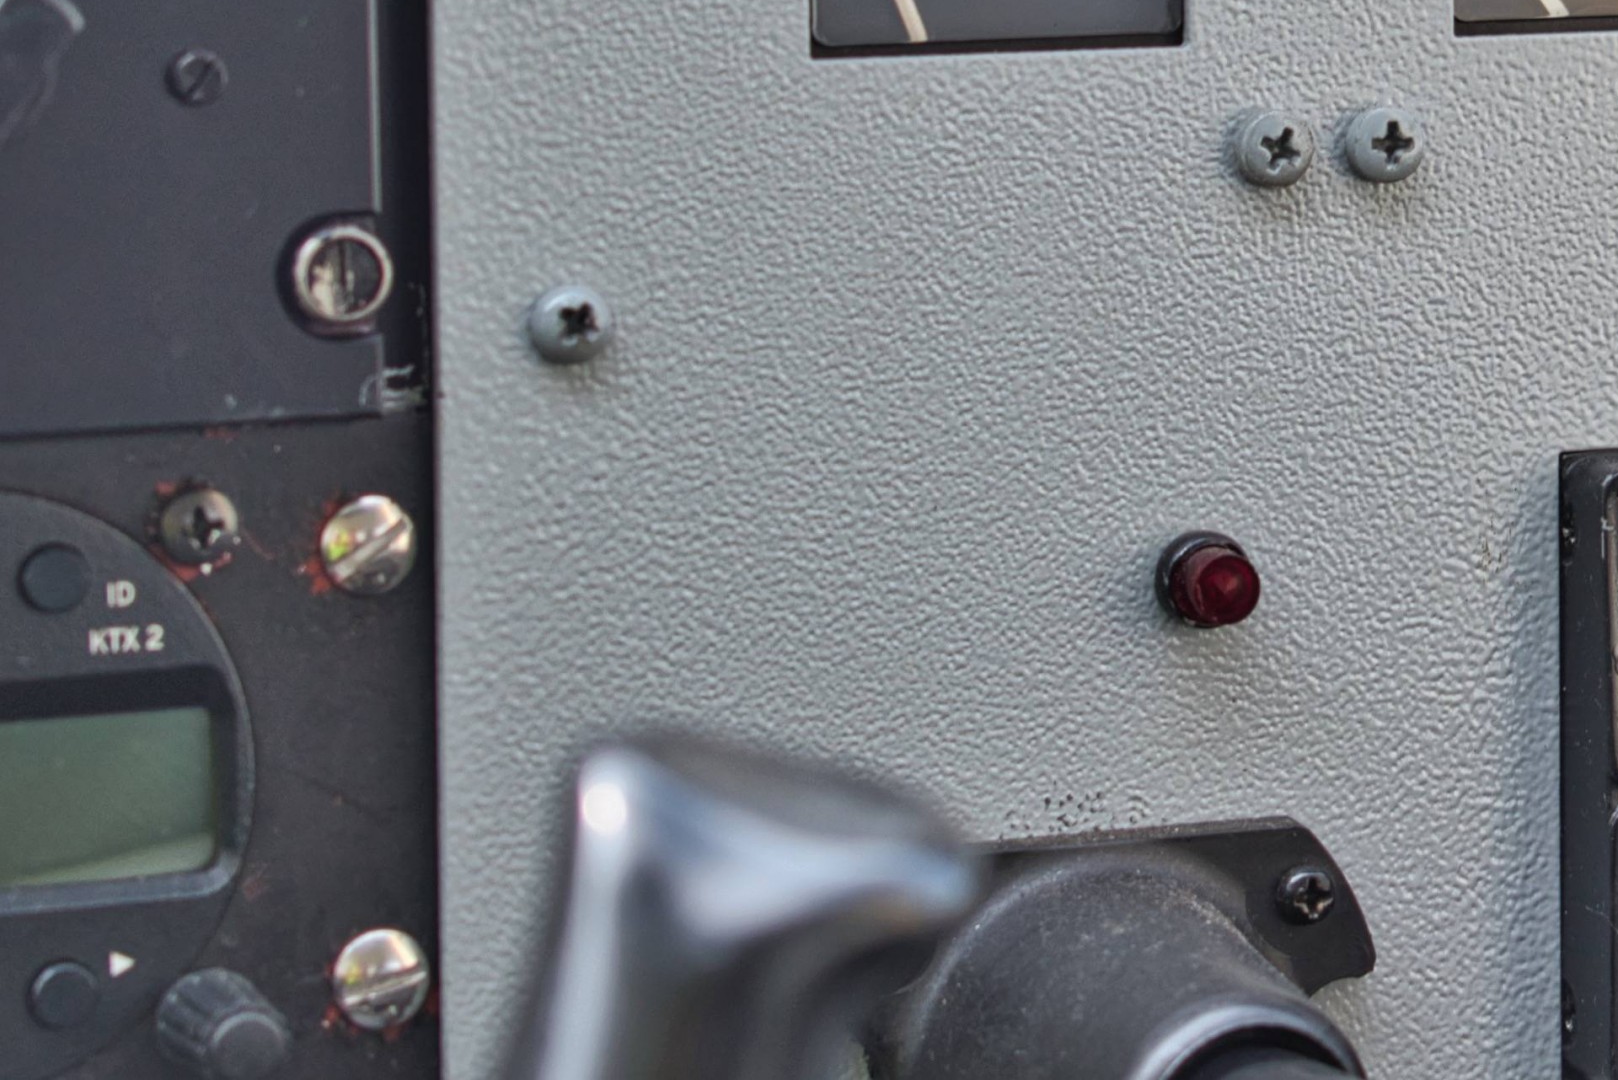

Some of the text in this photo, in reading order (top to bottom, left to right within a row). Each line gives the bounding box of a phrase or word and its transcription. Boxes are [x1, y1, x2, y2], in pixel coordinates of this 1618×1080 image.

[106, 580, 136, 609] ID
[88, 623, 165, 656] KTX 2
